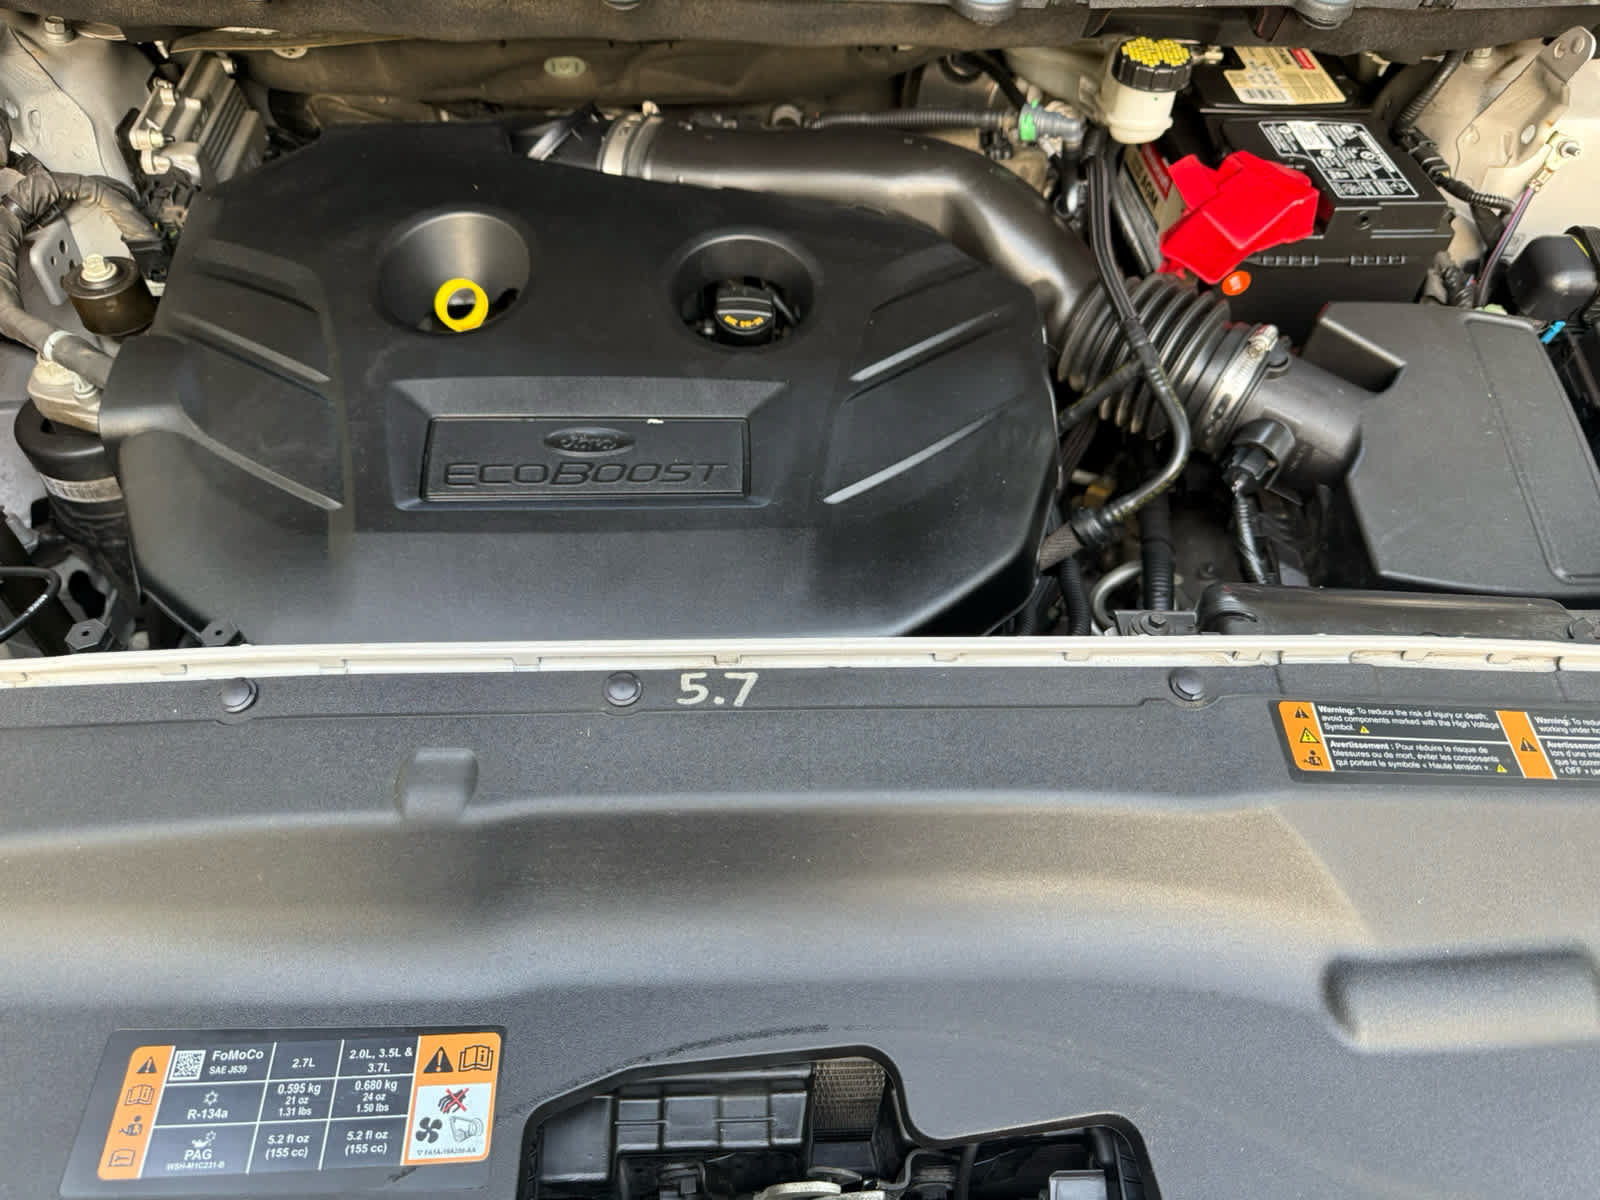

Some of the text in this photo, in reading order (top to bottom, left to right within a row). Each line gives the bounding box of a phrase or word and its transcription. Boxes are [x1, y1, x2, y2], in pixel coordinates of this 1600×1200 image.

[676, 671, 758, 707] 5.7
[1317, 705, 1355, 716] Warning:
[1356, 707, 1366, 715] To
[1368, 708, 1394, 716] reduce
[1395, 709, 1408, 717] the
[1409, 710, 1422, 718] risk
[1424, 710, 1433, 718] of
[1433, 711, 1453, 720] injury
[1321, 714, 1500, 730] avoid components marked with the High Voltage
[1330, 740, 1389, 750] Avertissement
[1452, 745, 1477, 755] risque
[1478, 746, 1488, 754] de
[1332, 750, 1371, 758] blessures
[1383, 751, 1394, 759] de
[1439, 753, 1452, 761] les
[1335, 759, 1349, 767] qui
[1350, 759, 1378, 768] portent
[1387, 760, 1420, 770] symbole
[1428, 761, 1452, 769] Haute
[1453, 763, 1482, 771] tension
[212, 1048, 264, 1061] FoMoCo
[349, 1046, 413, 1060] 2.0L, 3.5L &
[291, 1057, 316, 1069] 2.7L
[367, 1062, 391, 1073] 3.7L
[209, 1065, 227, 1075] SAE
[277, 1082, 321, 1096] 0.595 kg
[354, 1079, 398, 1092] 0.680 kg
[285, 1095, 309, 1105] 21 oz
[362, 1092, 386, 1102] 24 oz
[278, 1106, 312, 1117] 1.31 lbs
[356, 1102, 389, 1113] 1.50 lbs
[187, 1108, 229, 1120] R-134a
[267, 1133, 310, 1145] 5.2 fl oz
[346, 1129, 389, 1140] 5.2 fl oz
[184, 1149, 212, 1161] PAG
[265, 1146, 308, 1160] (155 cc)
[344, 1142, 388, 1156] (155 cc)
